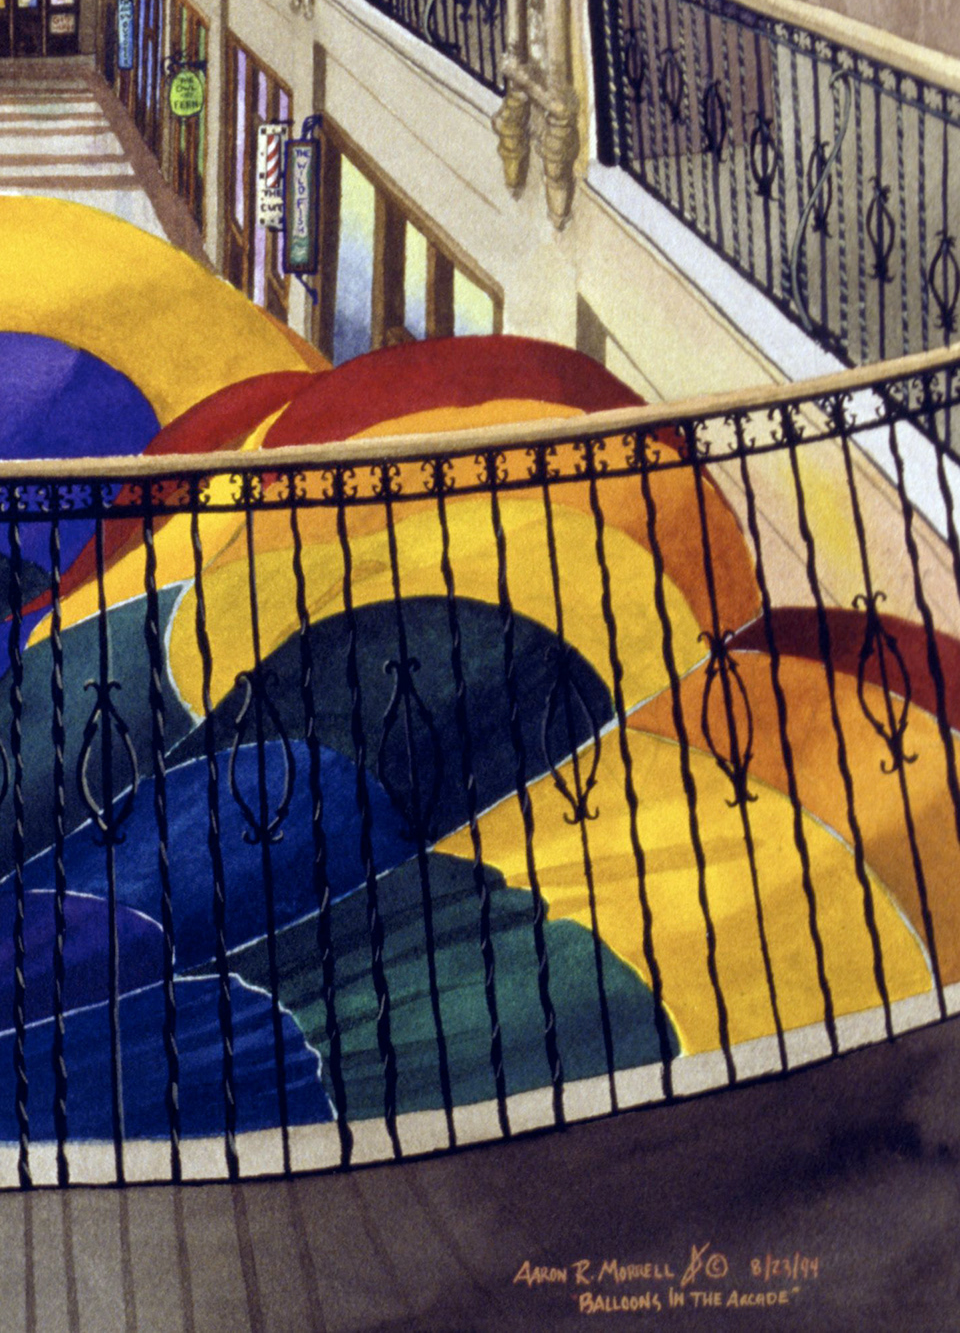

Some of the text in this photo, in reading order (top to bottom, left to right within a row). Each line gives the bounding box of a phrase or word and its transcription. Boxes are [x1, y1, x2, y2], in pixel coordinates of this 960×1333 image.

[294, 149, 310, 158] THE
[513, 1260, 568, 1287] AARON
[690, 1291, 722, 1307] THE
